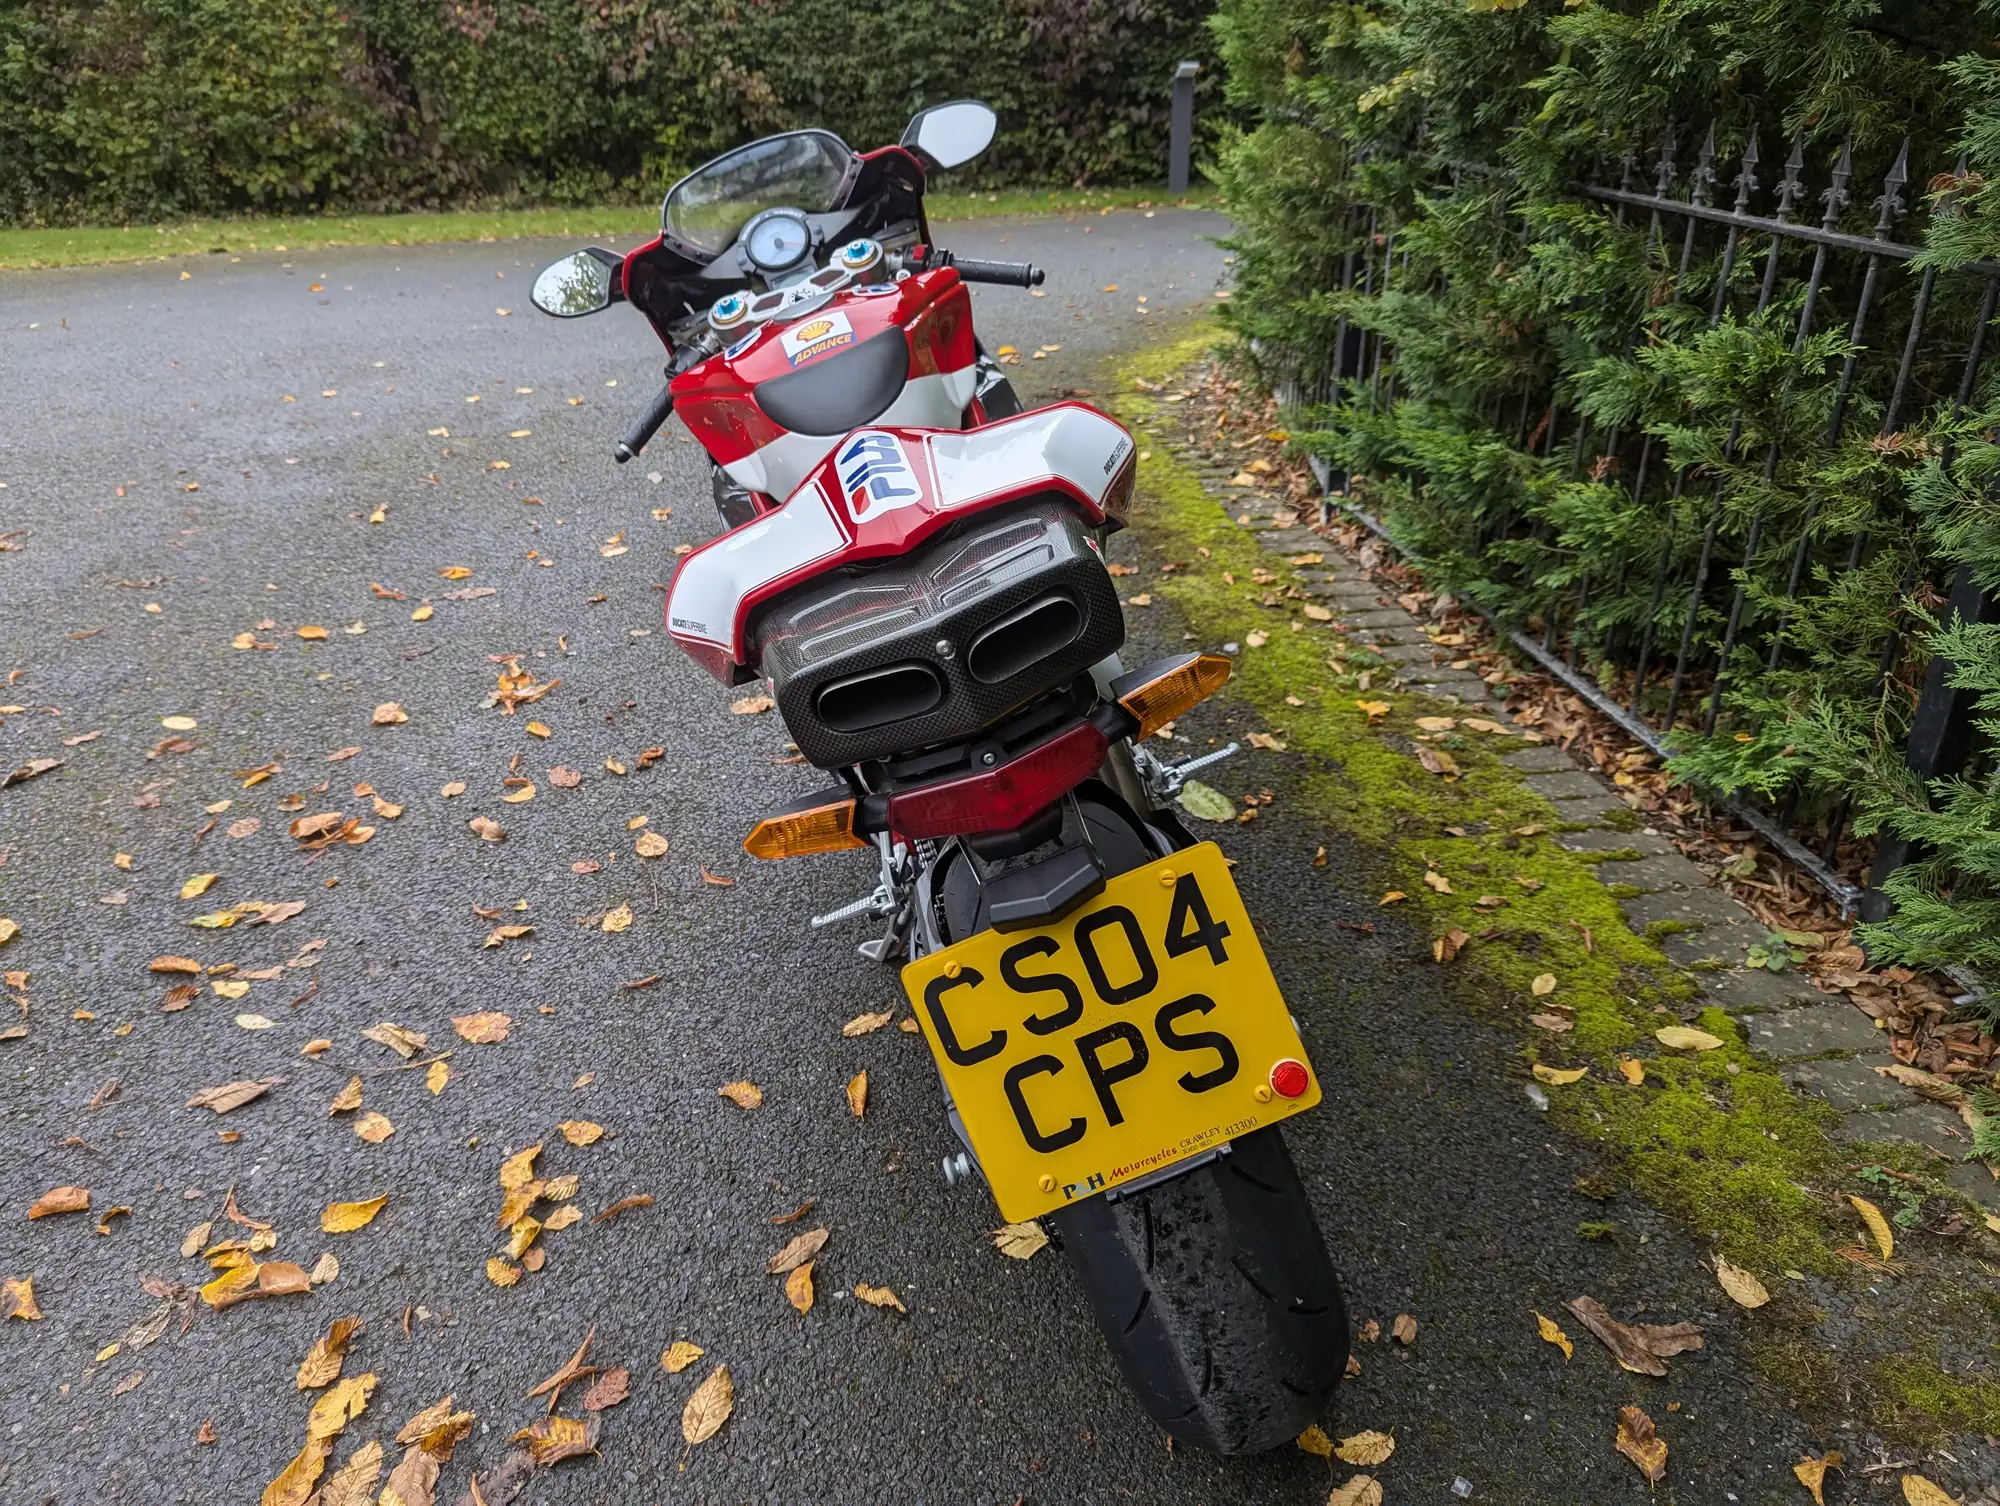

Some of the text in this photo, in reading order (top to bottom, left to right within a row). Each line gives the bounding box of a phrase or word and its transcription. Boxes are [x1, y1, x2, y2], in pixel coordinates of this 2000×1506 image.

[794, 333, 853, 366] ADVANCE
[1103, 453, 1116, 476] DUCATI
[672, 617, 687, 630] DUCATI
[1003, 993, 1240, 1154] CPS
[1180, 1116, 1258, 1148] CRAWLEY 413300
[1062, 1148, 1178, 1200] P&H Motorcycles
